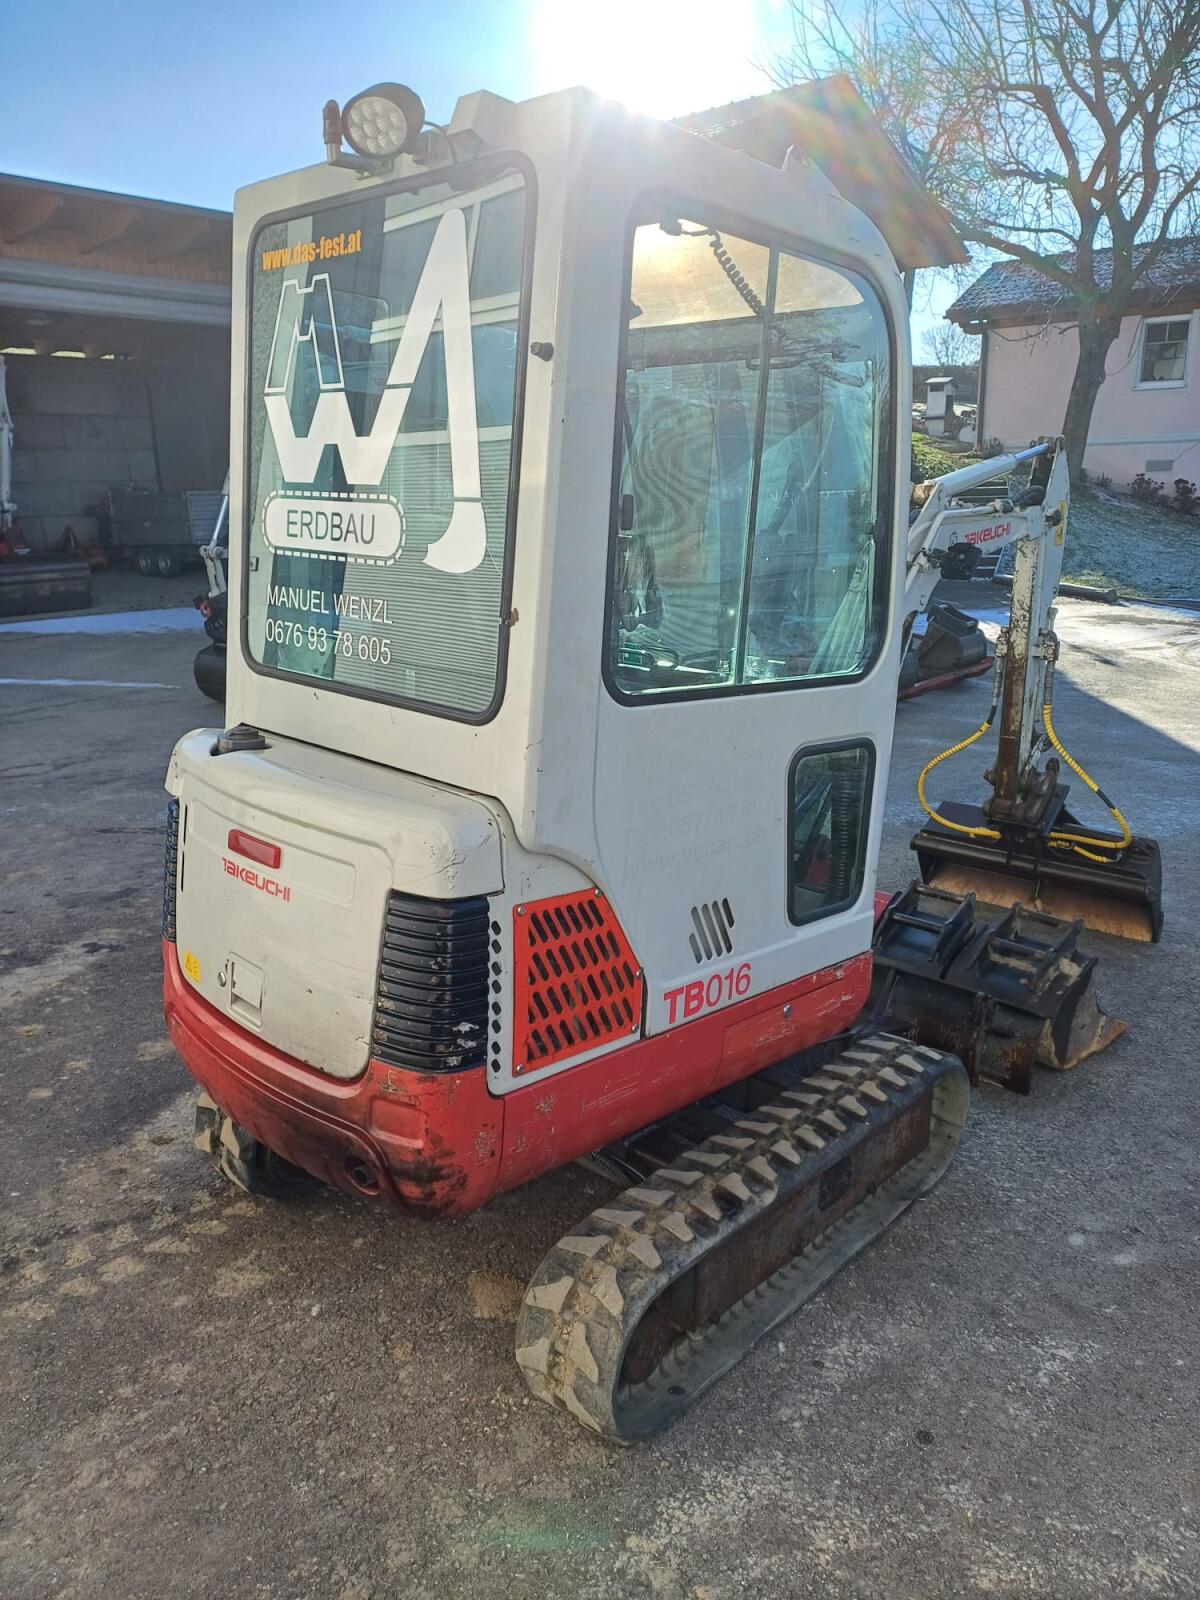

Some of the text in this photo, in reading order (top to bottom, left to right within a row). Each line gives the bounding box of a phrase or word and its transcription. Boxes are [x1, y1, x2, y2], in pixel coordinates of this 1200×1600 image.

[262, 229, 363, 272] www.das-fest.at
[286, 509, 376, 545] ERDBAU
[267, 584, 393, 625] MANUEL WENZL
[265, 618, 392, 665] 0676 93 78 605
[663, 962, 752, 1025] TB016
